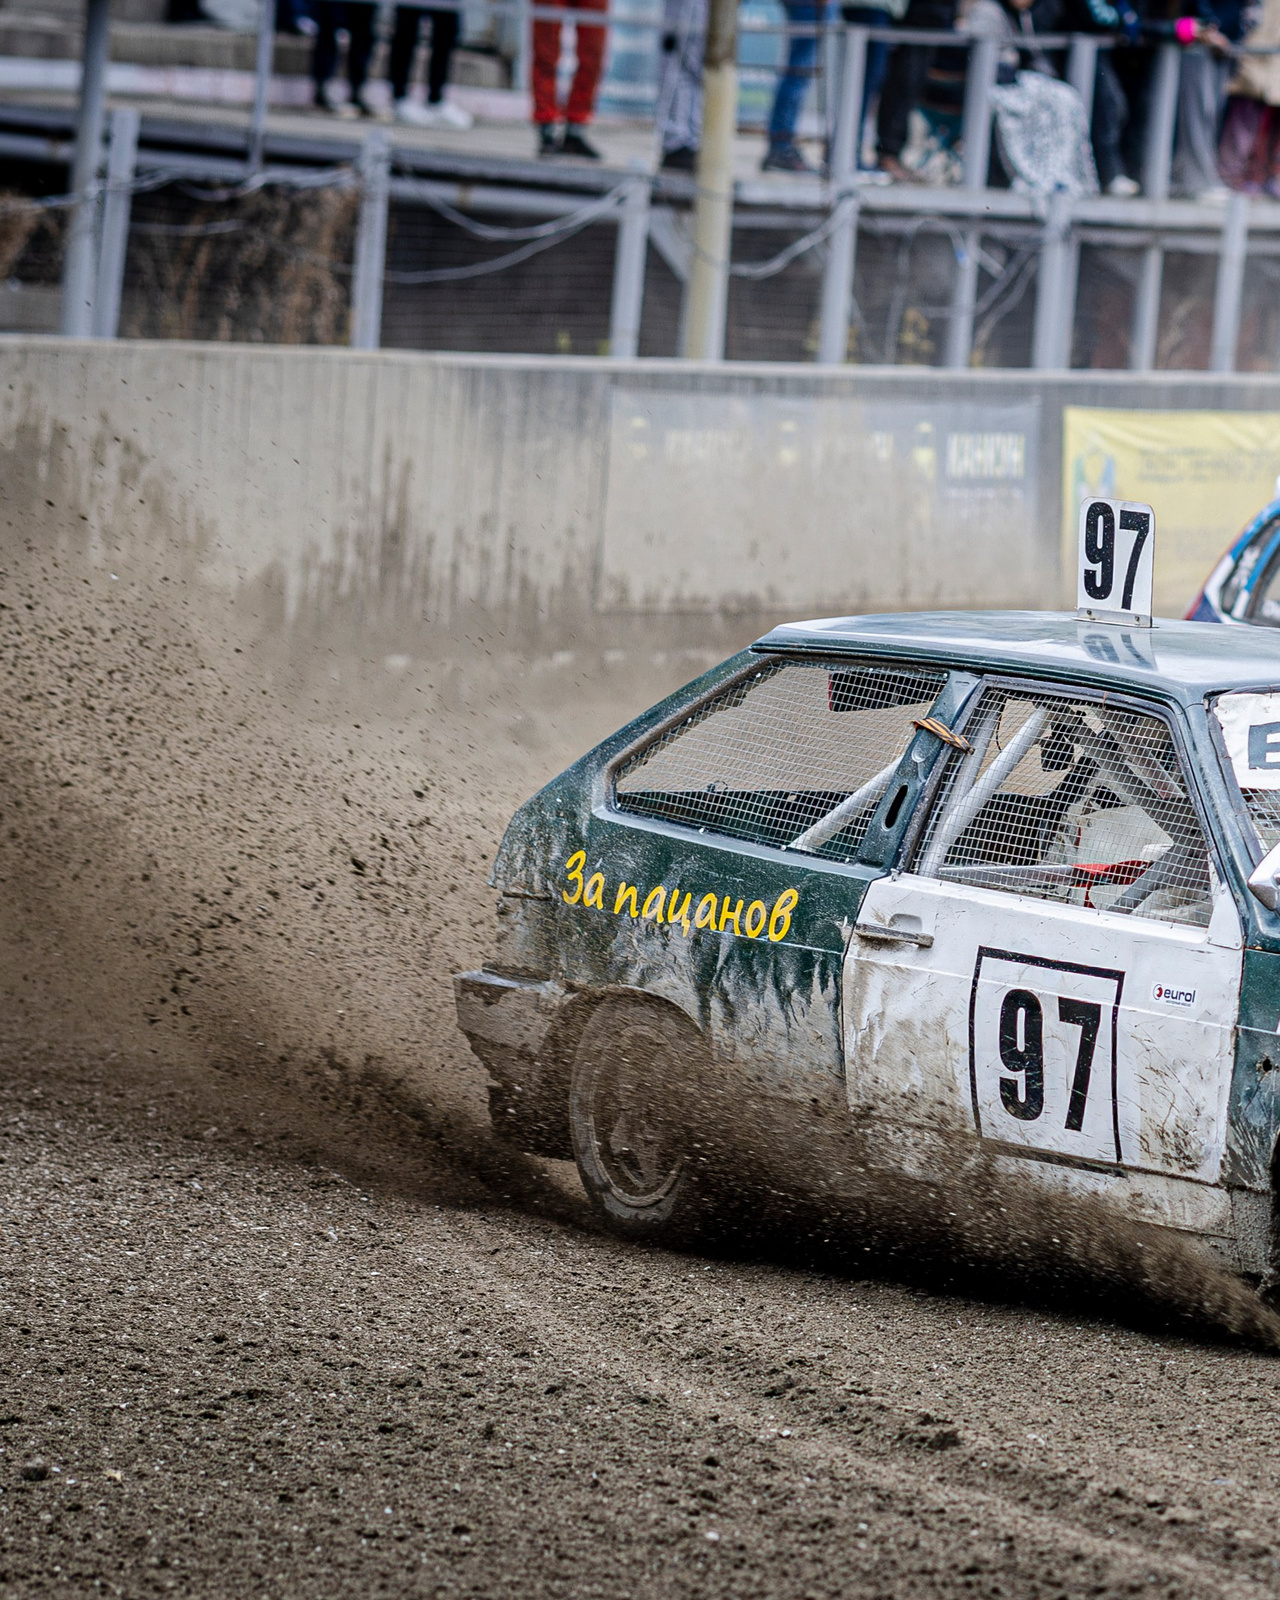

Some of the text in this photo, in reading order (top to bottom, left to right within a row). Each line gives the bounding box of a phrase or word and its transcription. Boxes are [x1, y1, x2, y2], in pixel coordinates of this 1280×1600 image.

[1084, 502, 1150, 610] 97
[561, 850, 799, 942] За пацанов
[1163, 988, 1196, 1004] eurol
[998, 988, 1102, 1132] 97
